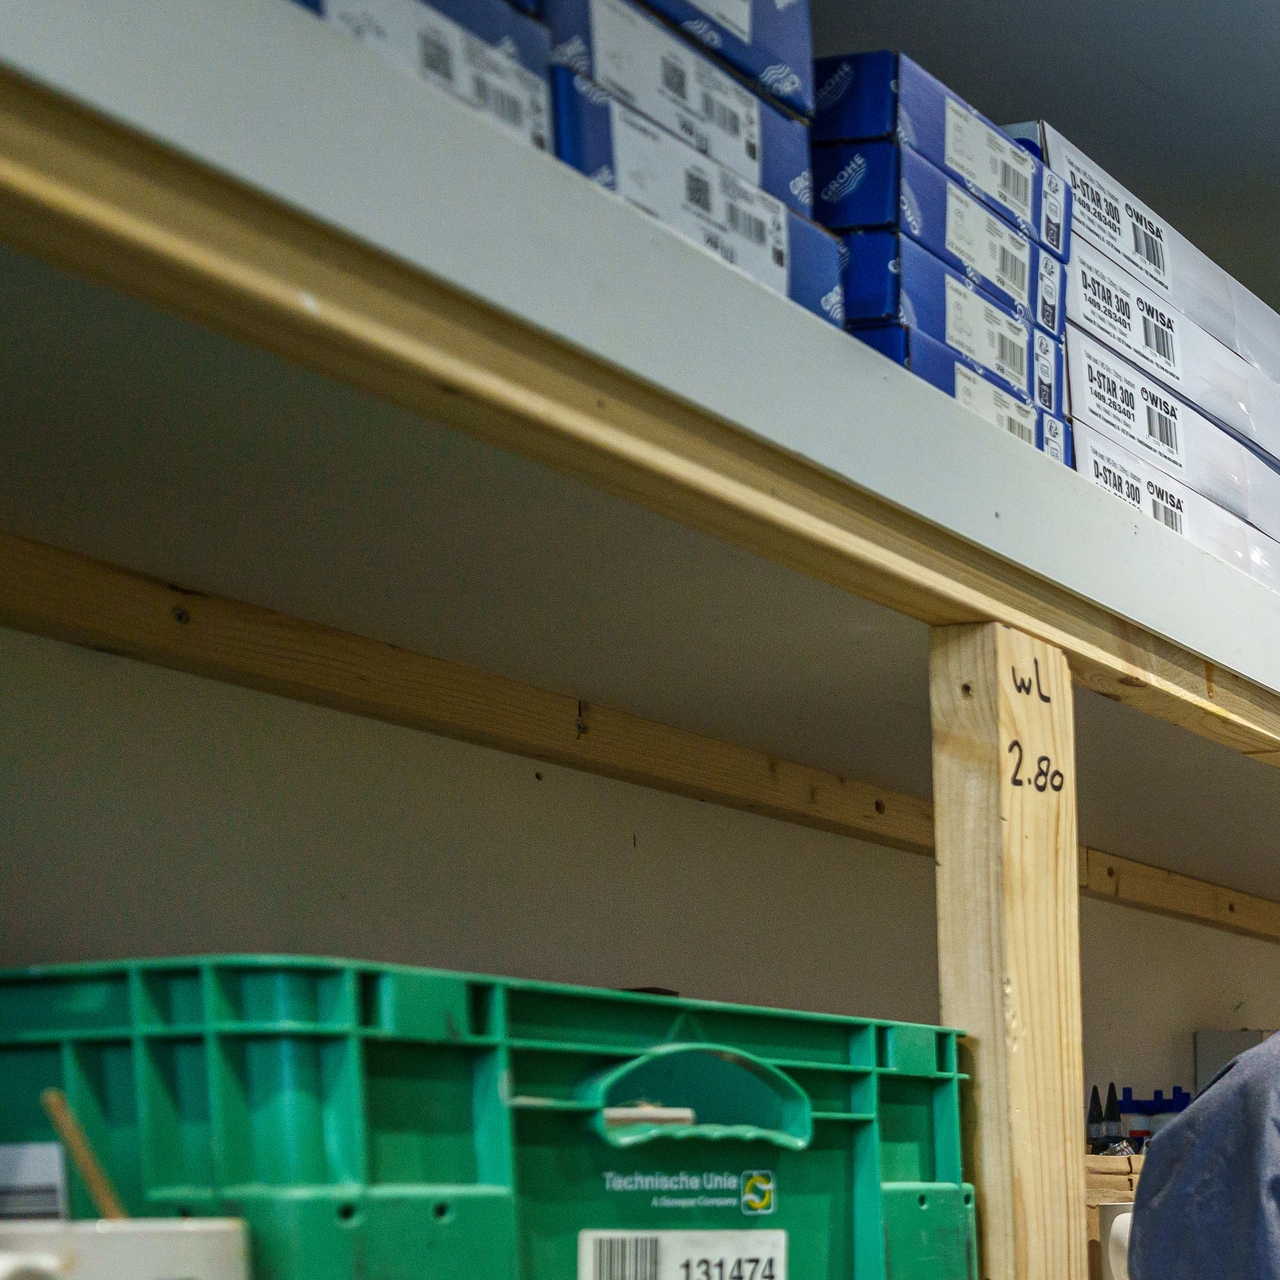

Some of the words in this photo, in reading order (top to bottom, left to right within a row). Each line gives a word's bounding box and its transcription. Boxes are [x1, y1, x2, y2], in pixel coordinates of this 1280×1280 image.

[820, 153, 865, 200] GROHE
[1069, 169, 1102, 207] D-STAR
[1104, 197, 1121, 225] 300
[1133, 206, 1164, 242] WISA
[1081, 269, 1113, 309] D-STAR
[1114, 293, 1131, 320] 300
[1144, 300, 1175, 333] WISA
[1087, 363, 1117, 399] D-STAR
[1119, 385, 1135, 411] 300
[1149, 391, 1178, 420] WISA
[1093, 458, 1124, 496] D-STAR
[1125, 479, 1141, 505] 300
[1154, 484, 1184, 513] WISA
[1008, 739, 1064, 782] 2.80
[602, 1170, 700, 1191] Technische
[702, 1171, 738, 1190] Unie
